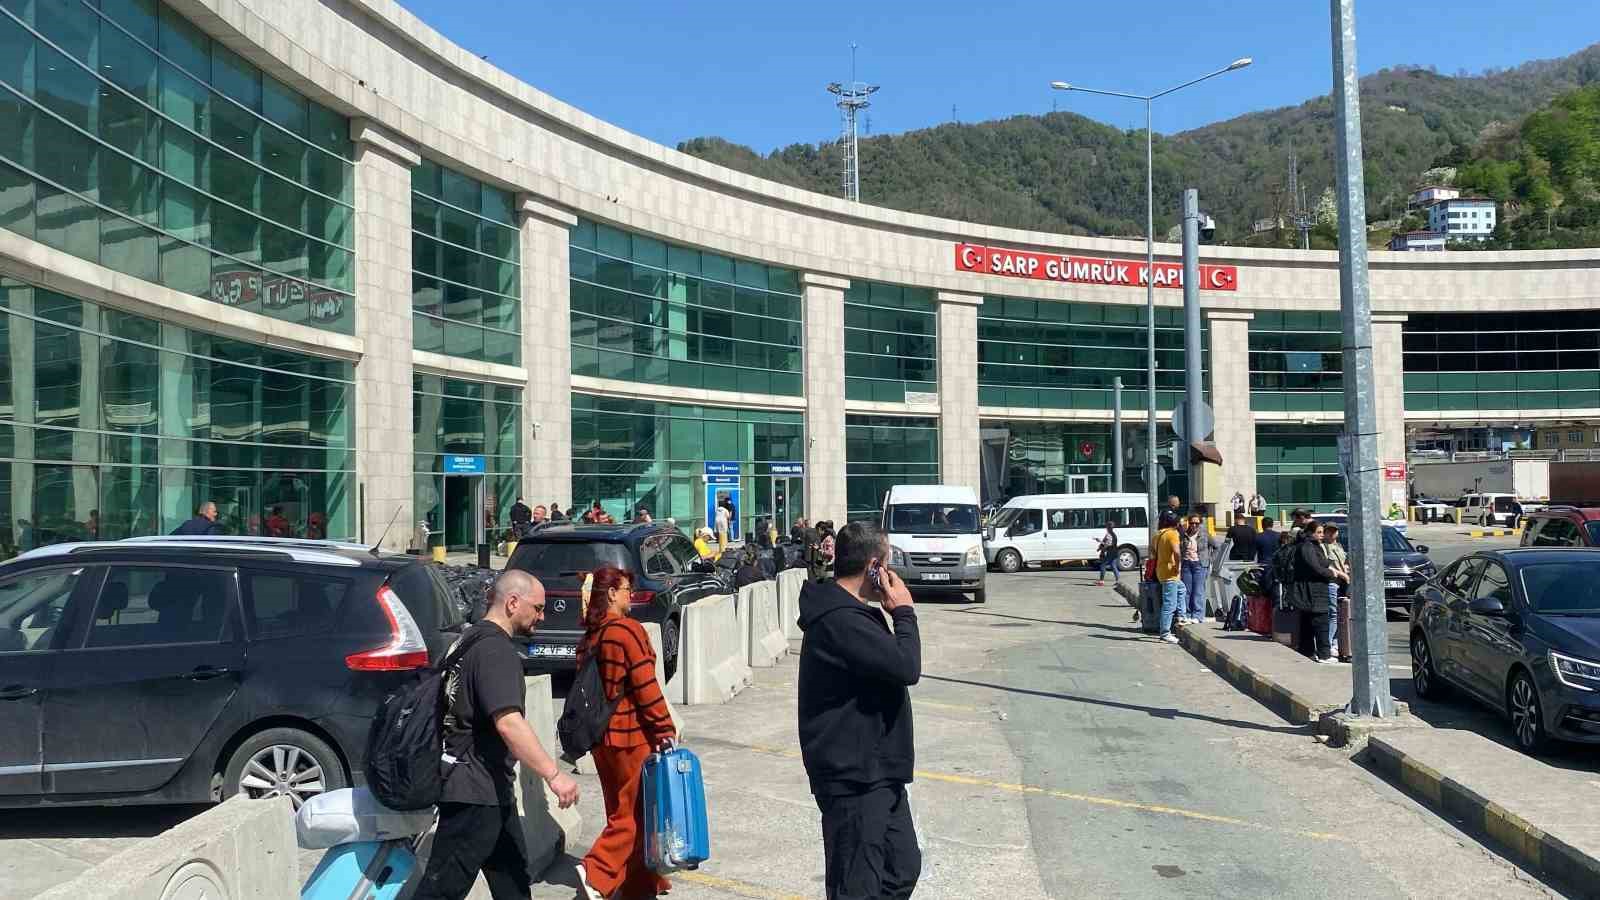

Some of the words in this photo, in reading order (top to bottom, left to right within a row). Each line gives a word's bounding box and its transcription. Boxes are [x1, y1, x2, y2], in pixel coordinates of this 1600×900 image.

[991, 253, 1039, 275] SARP
[1045, 256, 1129, 283] GÜMRÜK
[1138, 267, 1200, 287] KAPI
